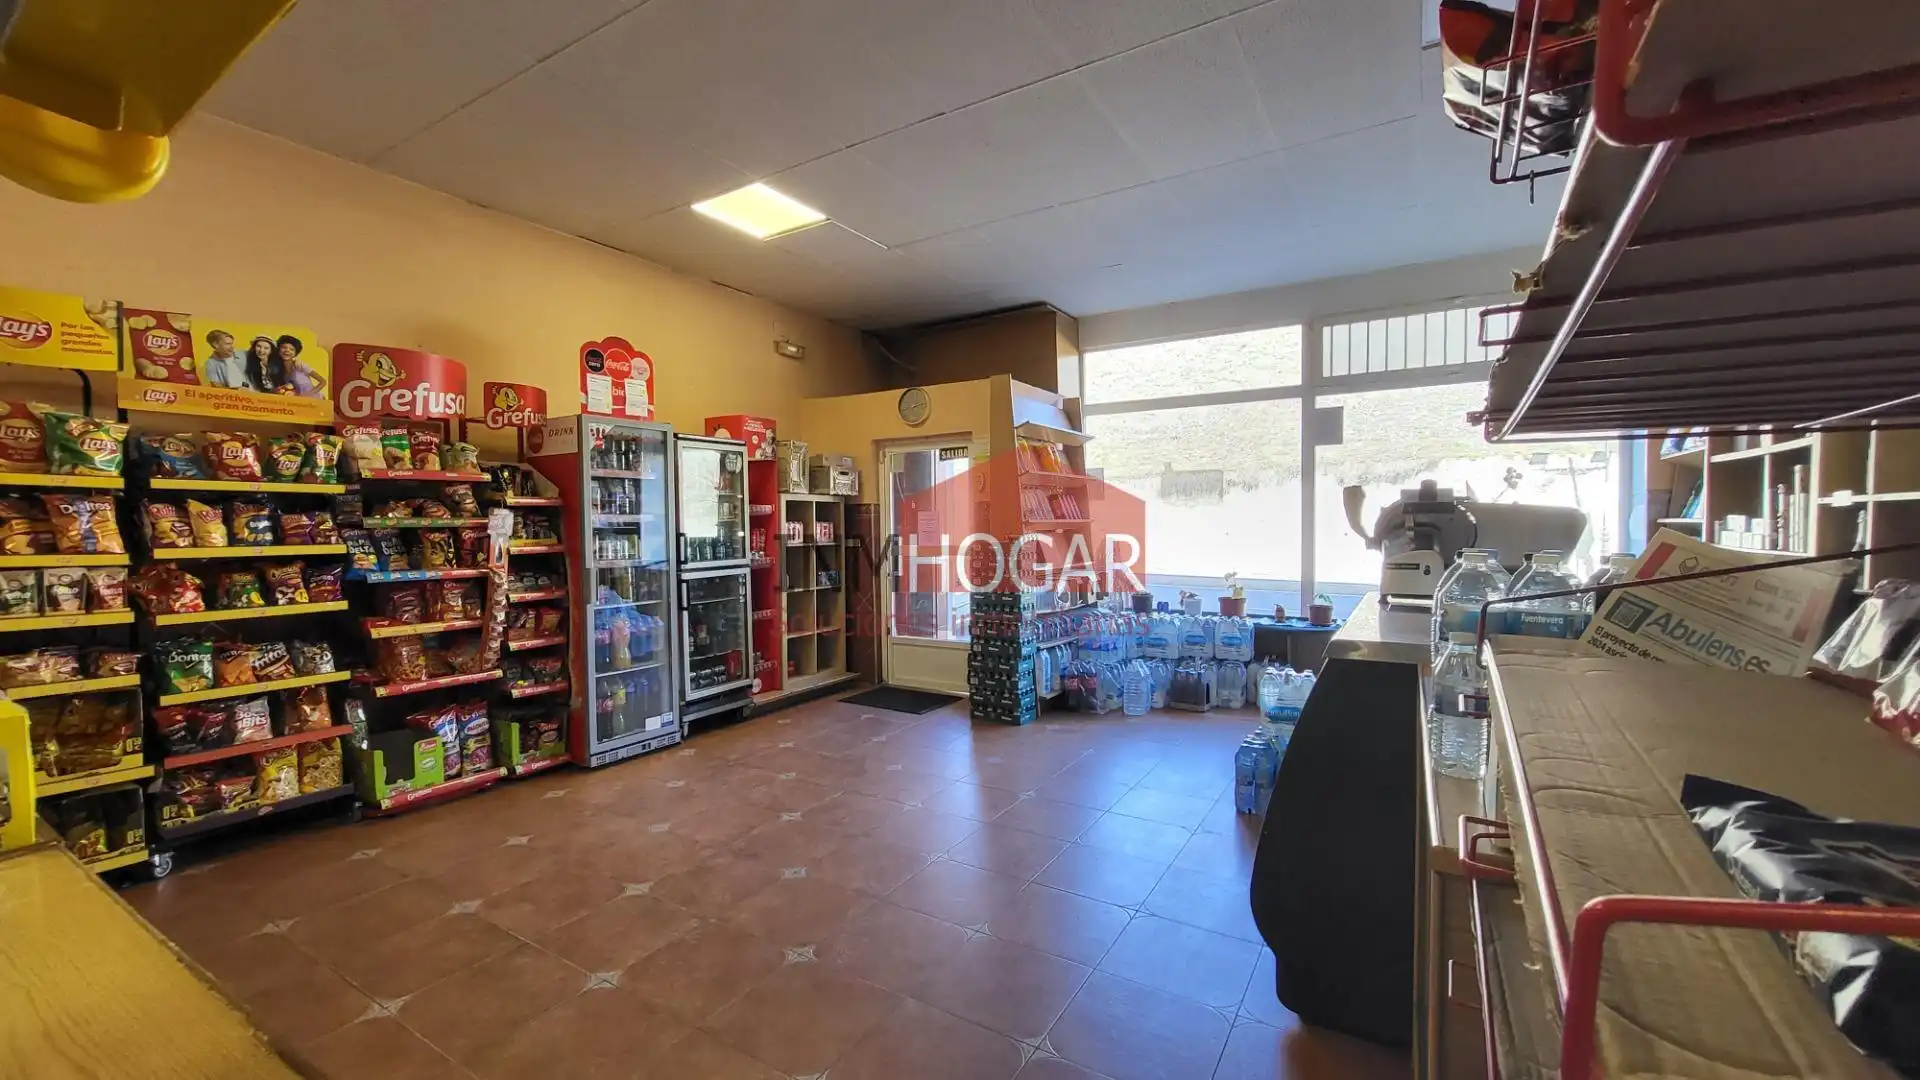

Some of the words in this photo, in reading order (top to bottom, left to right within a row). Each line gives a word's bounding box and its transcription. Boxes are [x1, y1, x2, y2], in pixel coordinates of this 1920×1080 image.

[147, 335, 178, 350] Lay's
[144, 388, 177, 404] Lay's
[184, 388, 197, 399] El
[339, 380, 467, 418] Grefusa
[212, 402, 240, 413] gran
[241, 404, 295, 416] momento
[548, 426, 575, 437] DRINK
[1601, 629, 1639, 655] proyecto
